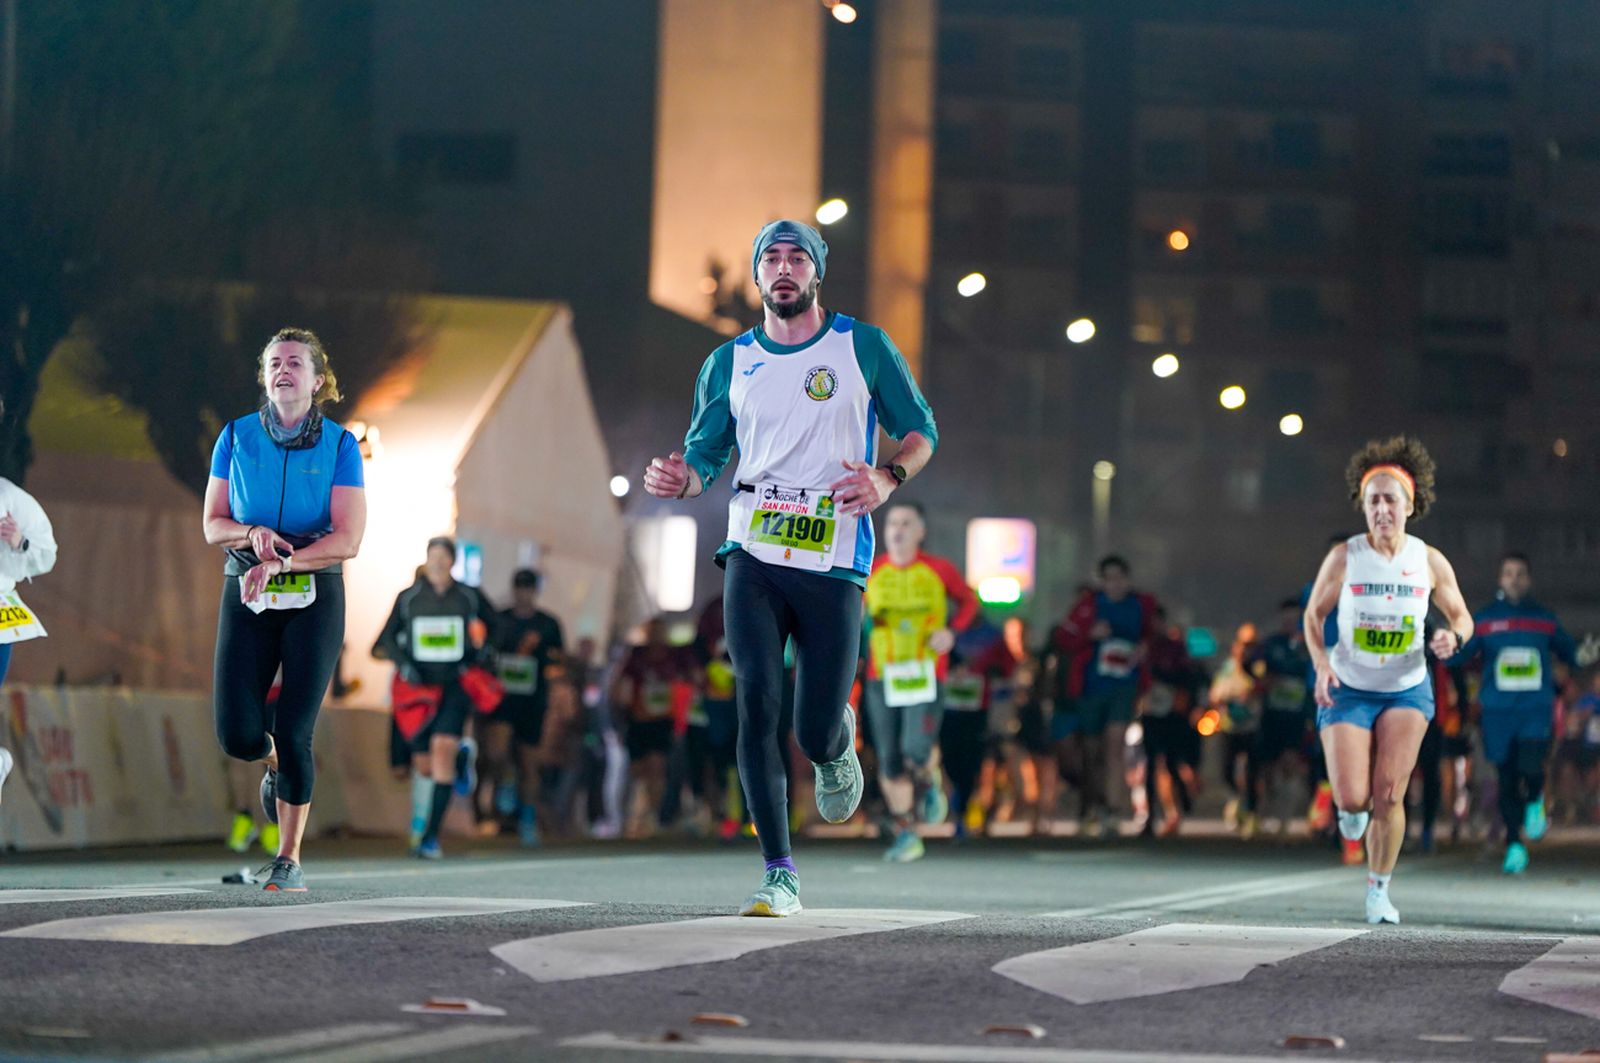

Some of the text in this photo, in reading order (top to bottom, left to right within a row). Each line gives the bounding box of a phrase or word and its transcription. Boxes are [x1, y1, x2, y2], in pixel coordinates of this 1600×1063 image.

[761, 501, 778, 511] SAN
[761, 512, 826, 543] 12190
[1366, 629, 1404, 648] 9477
